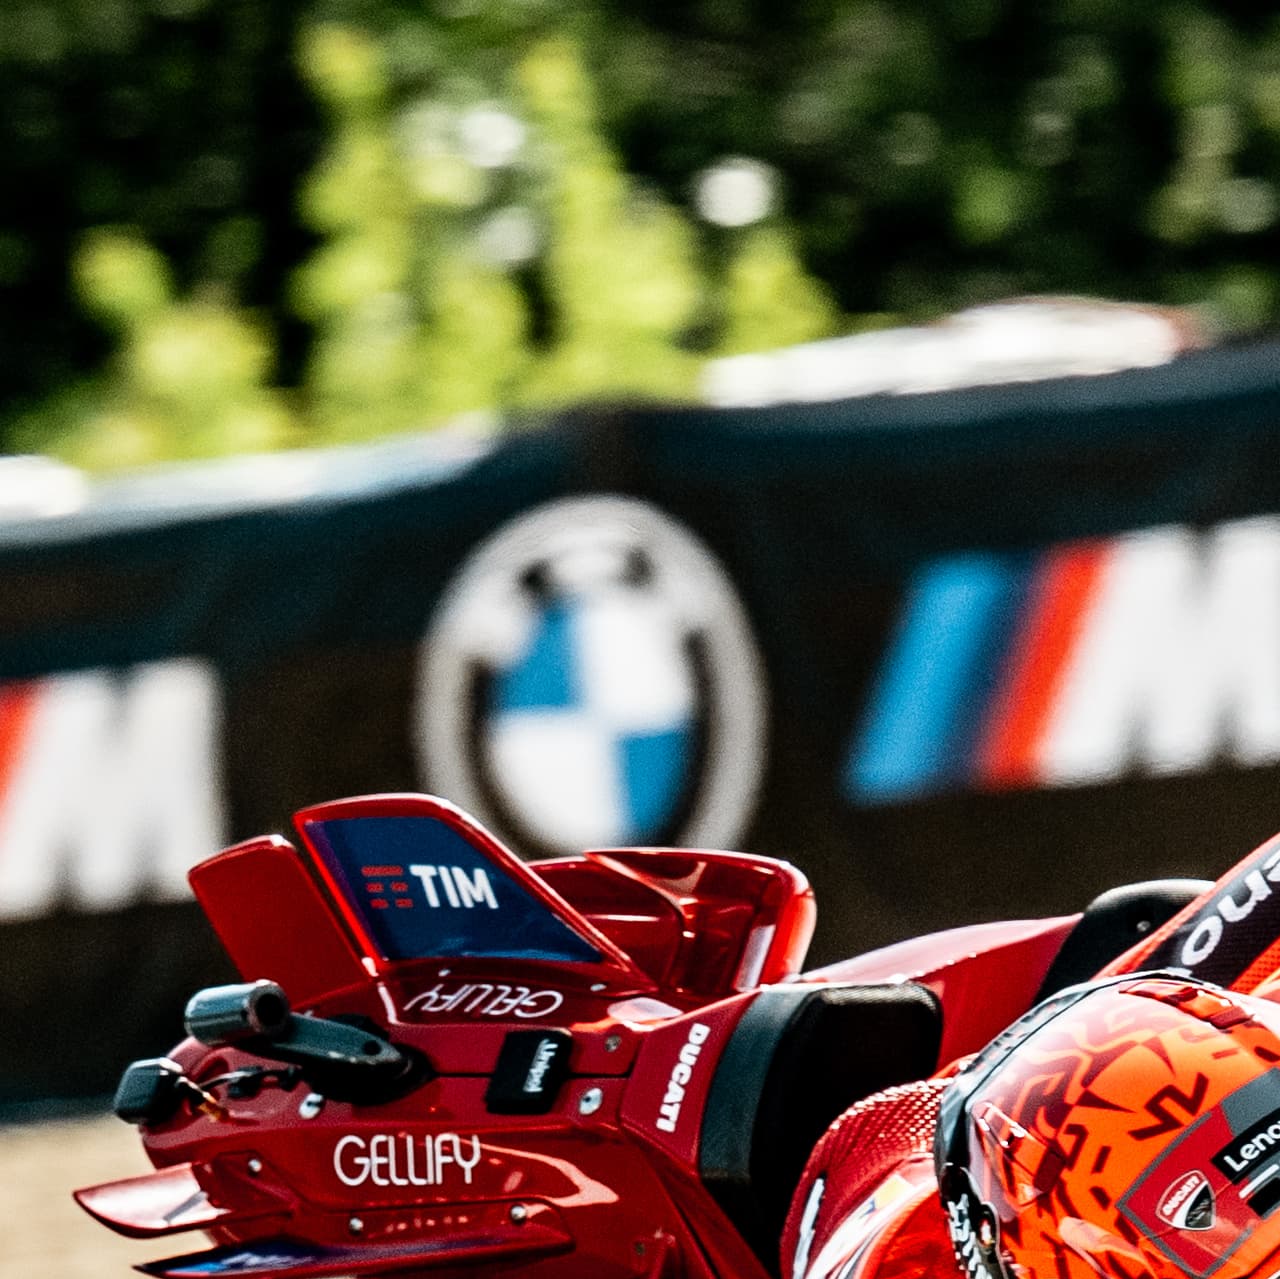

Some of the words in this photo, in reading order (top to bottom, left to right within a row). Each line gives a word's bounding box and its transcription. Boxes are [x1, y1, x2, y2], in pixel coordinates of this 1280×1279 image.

[409, 863, 500, 910] TIM
[403, 983, 564, 1019] GELLIFY
[655, 1022, 711, 1133] DUCATI
[333, 1133, 482, 1188] GELLIFY
